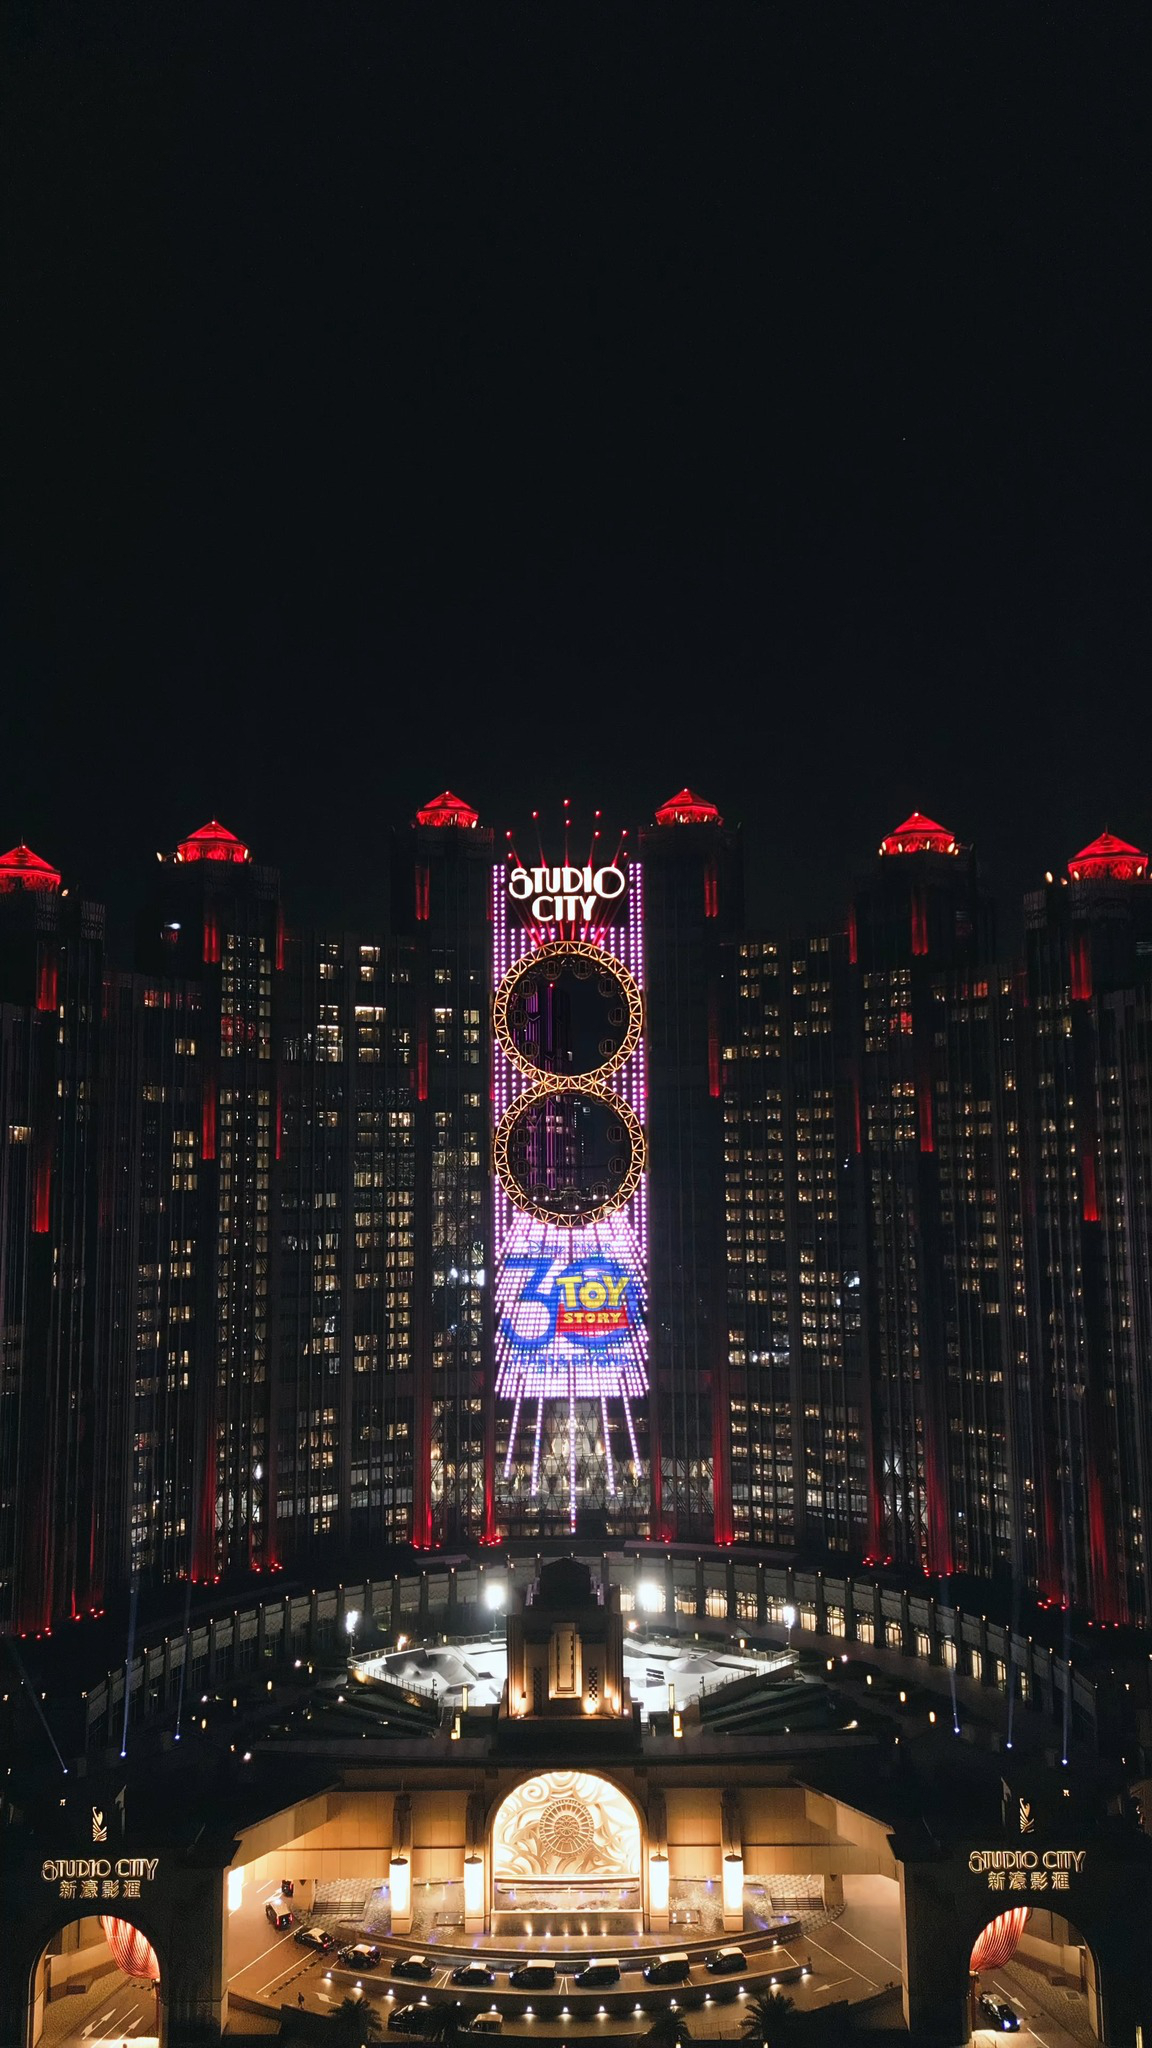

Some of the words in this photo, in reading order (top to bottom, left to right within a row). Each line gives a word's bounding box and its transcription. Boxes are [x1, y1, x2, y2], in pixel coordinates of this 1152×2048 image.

[508, 866, 626, 899] STUDIO
[531, 895, 597, 922] CITY
[556, 1275, 631, 1310] TOY
[563, 1312, 623, 1324] STORY
[42, 1859, 111, 1882] STUDIO
[115, 1858, 159, 1881] CITY
[968, 1850, 1039, 1874] STUDIO
[1042, 1850, 1086, 1873] CITY
